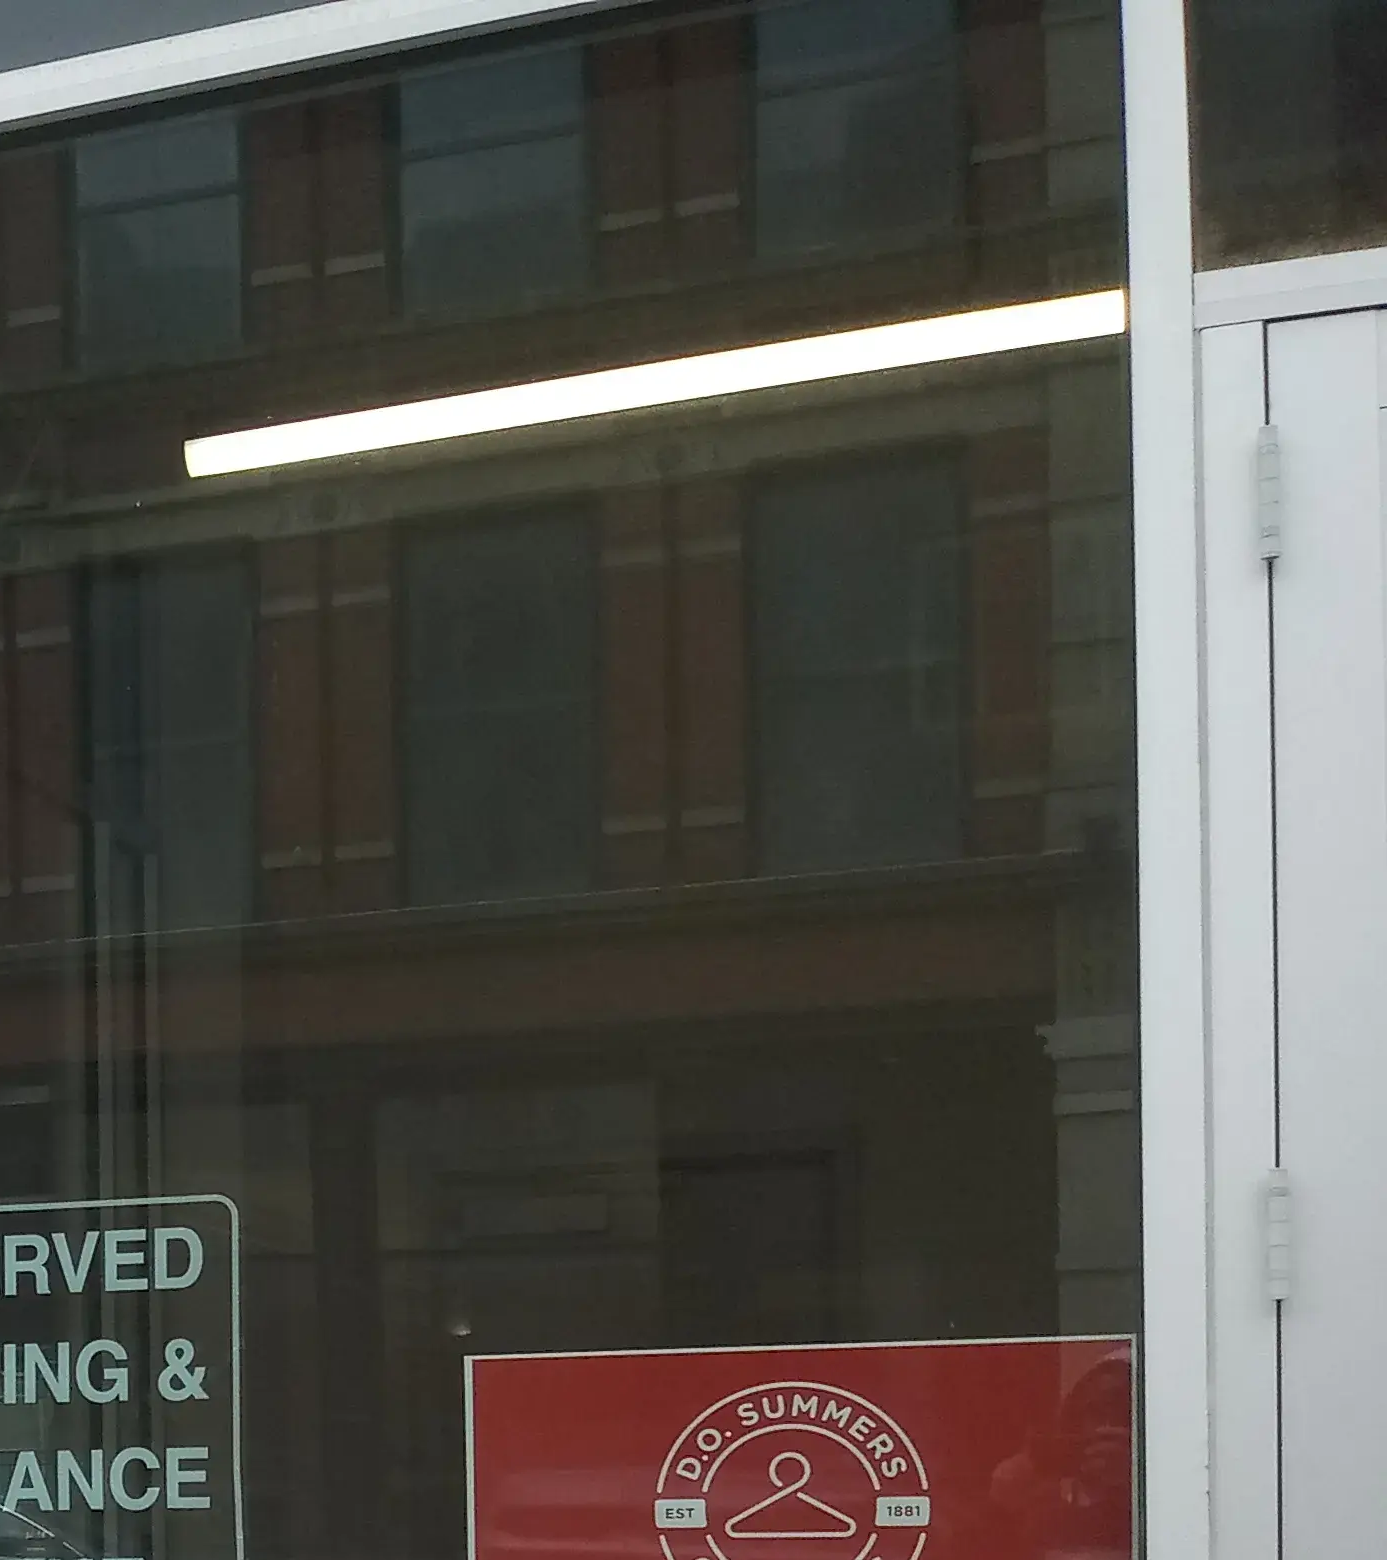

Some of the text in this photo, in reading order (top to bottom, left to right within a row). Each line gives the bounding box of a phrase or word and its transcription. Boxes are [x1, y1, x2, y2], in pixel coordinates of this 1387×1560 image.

[157, 1337, 211, 1402] &
[675, 1393, 909, 1482] D.O. SUMMERS
[664, 1506, 696, 1520] EST
[885, 1503, 922, 1518] 1881
